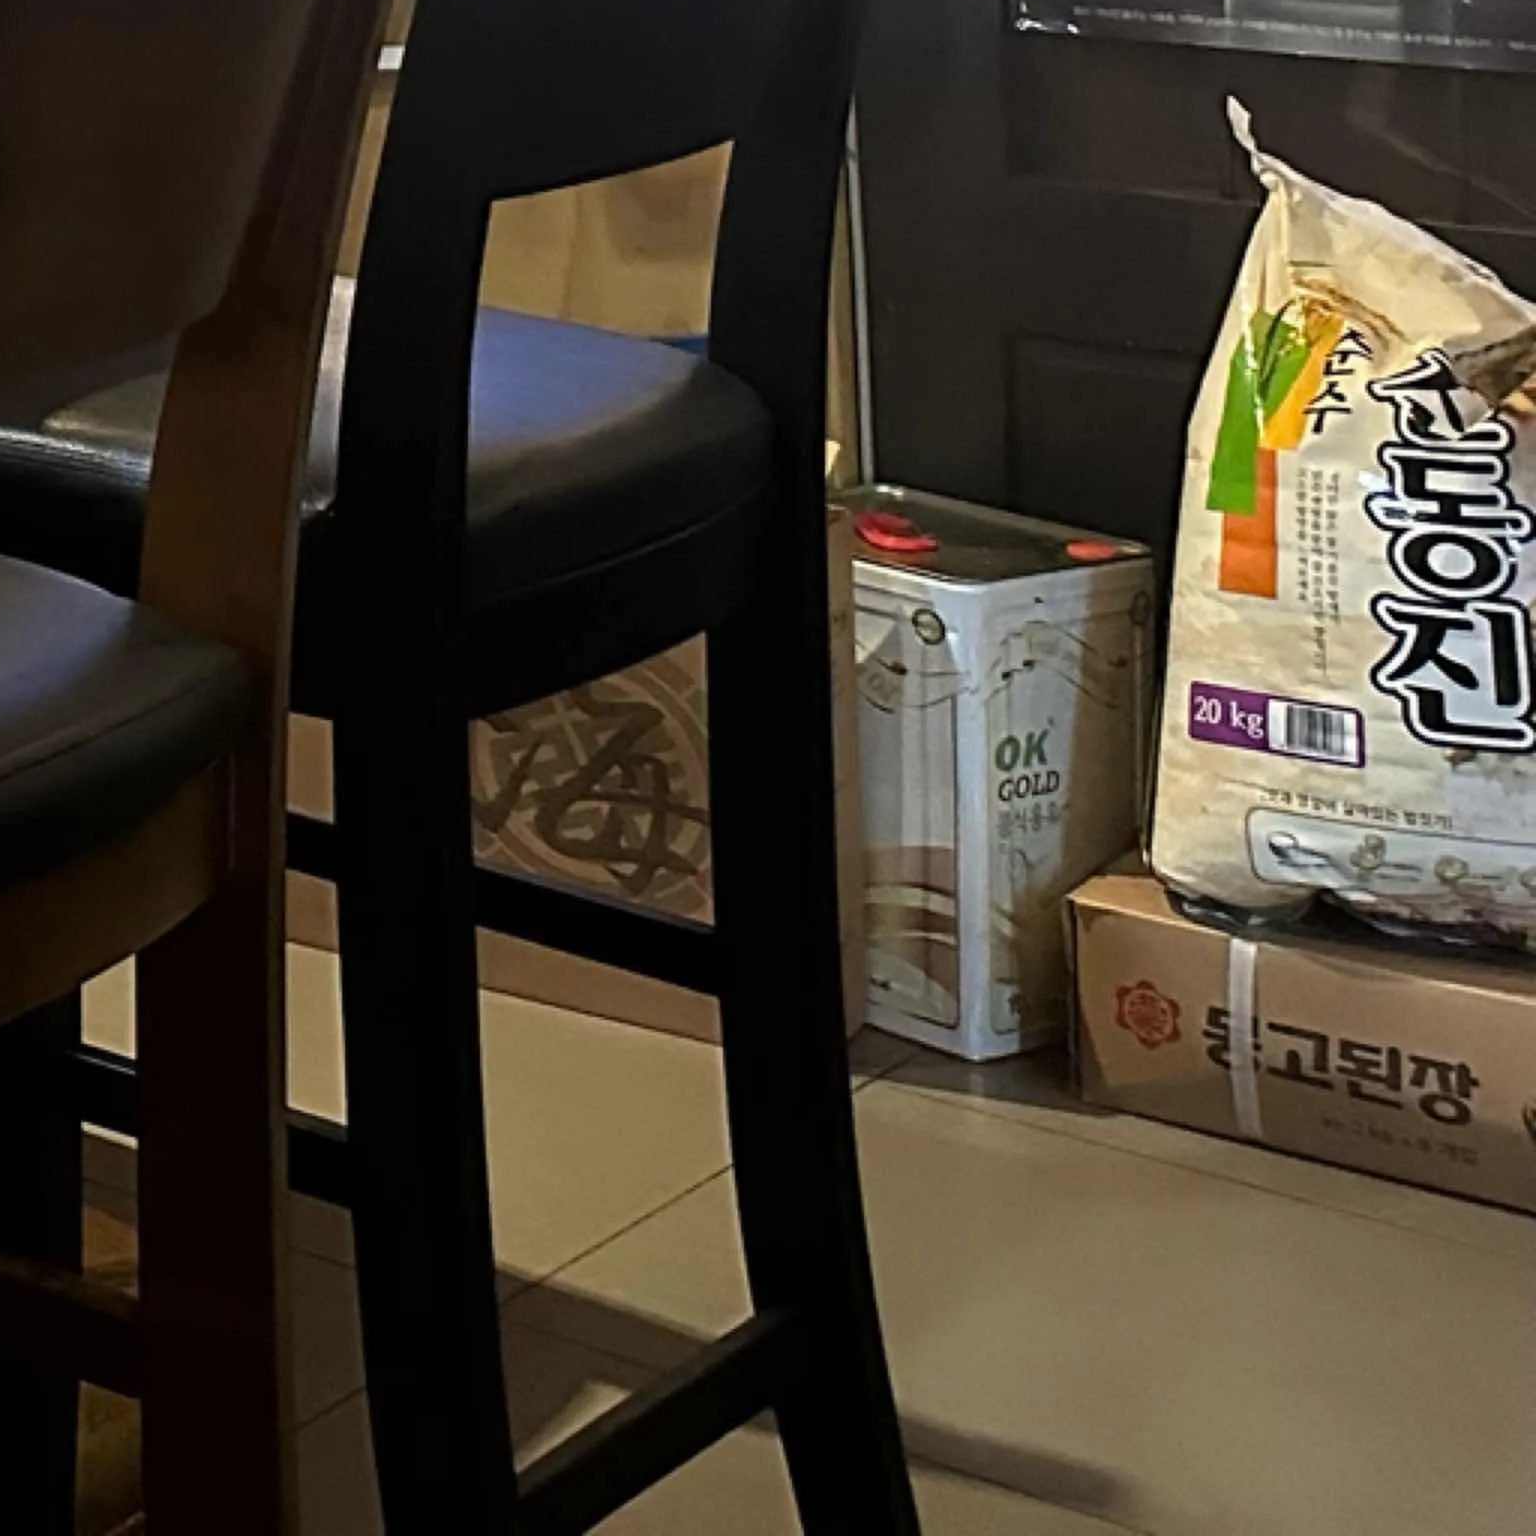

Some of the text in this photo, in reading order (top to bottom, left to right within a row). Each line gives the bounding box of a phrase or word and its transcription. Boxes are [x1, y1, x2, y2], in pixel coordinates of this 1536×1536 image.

[1303, 327, 1375, 435] 순수
[1192, 695, 1265, 740] 20 kg
[994, 728, 1051, 772] OK
[997, 769, 1061, 803] GOLD
